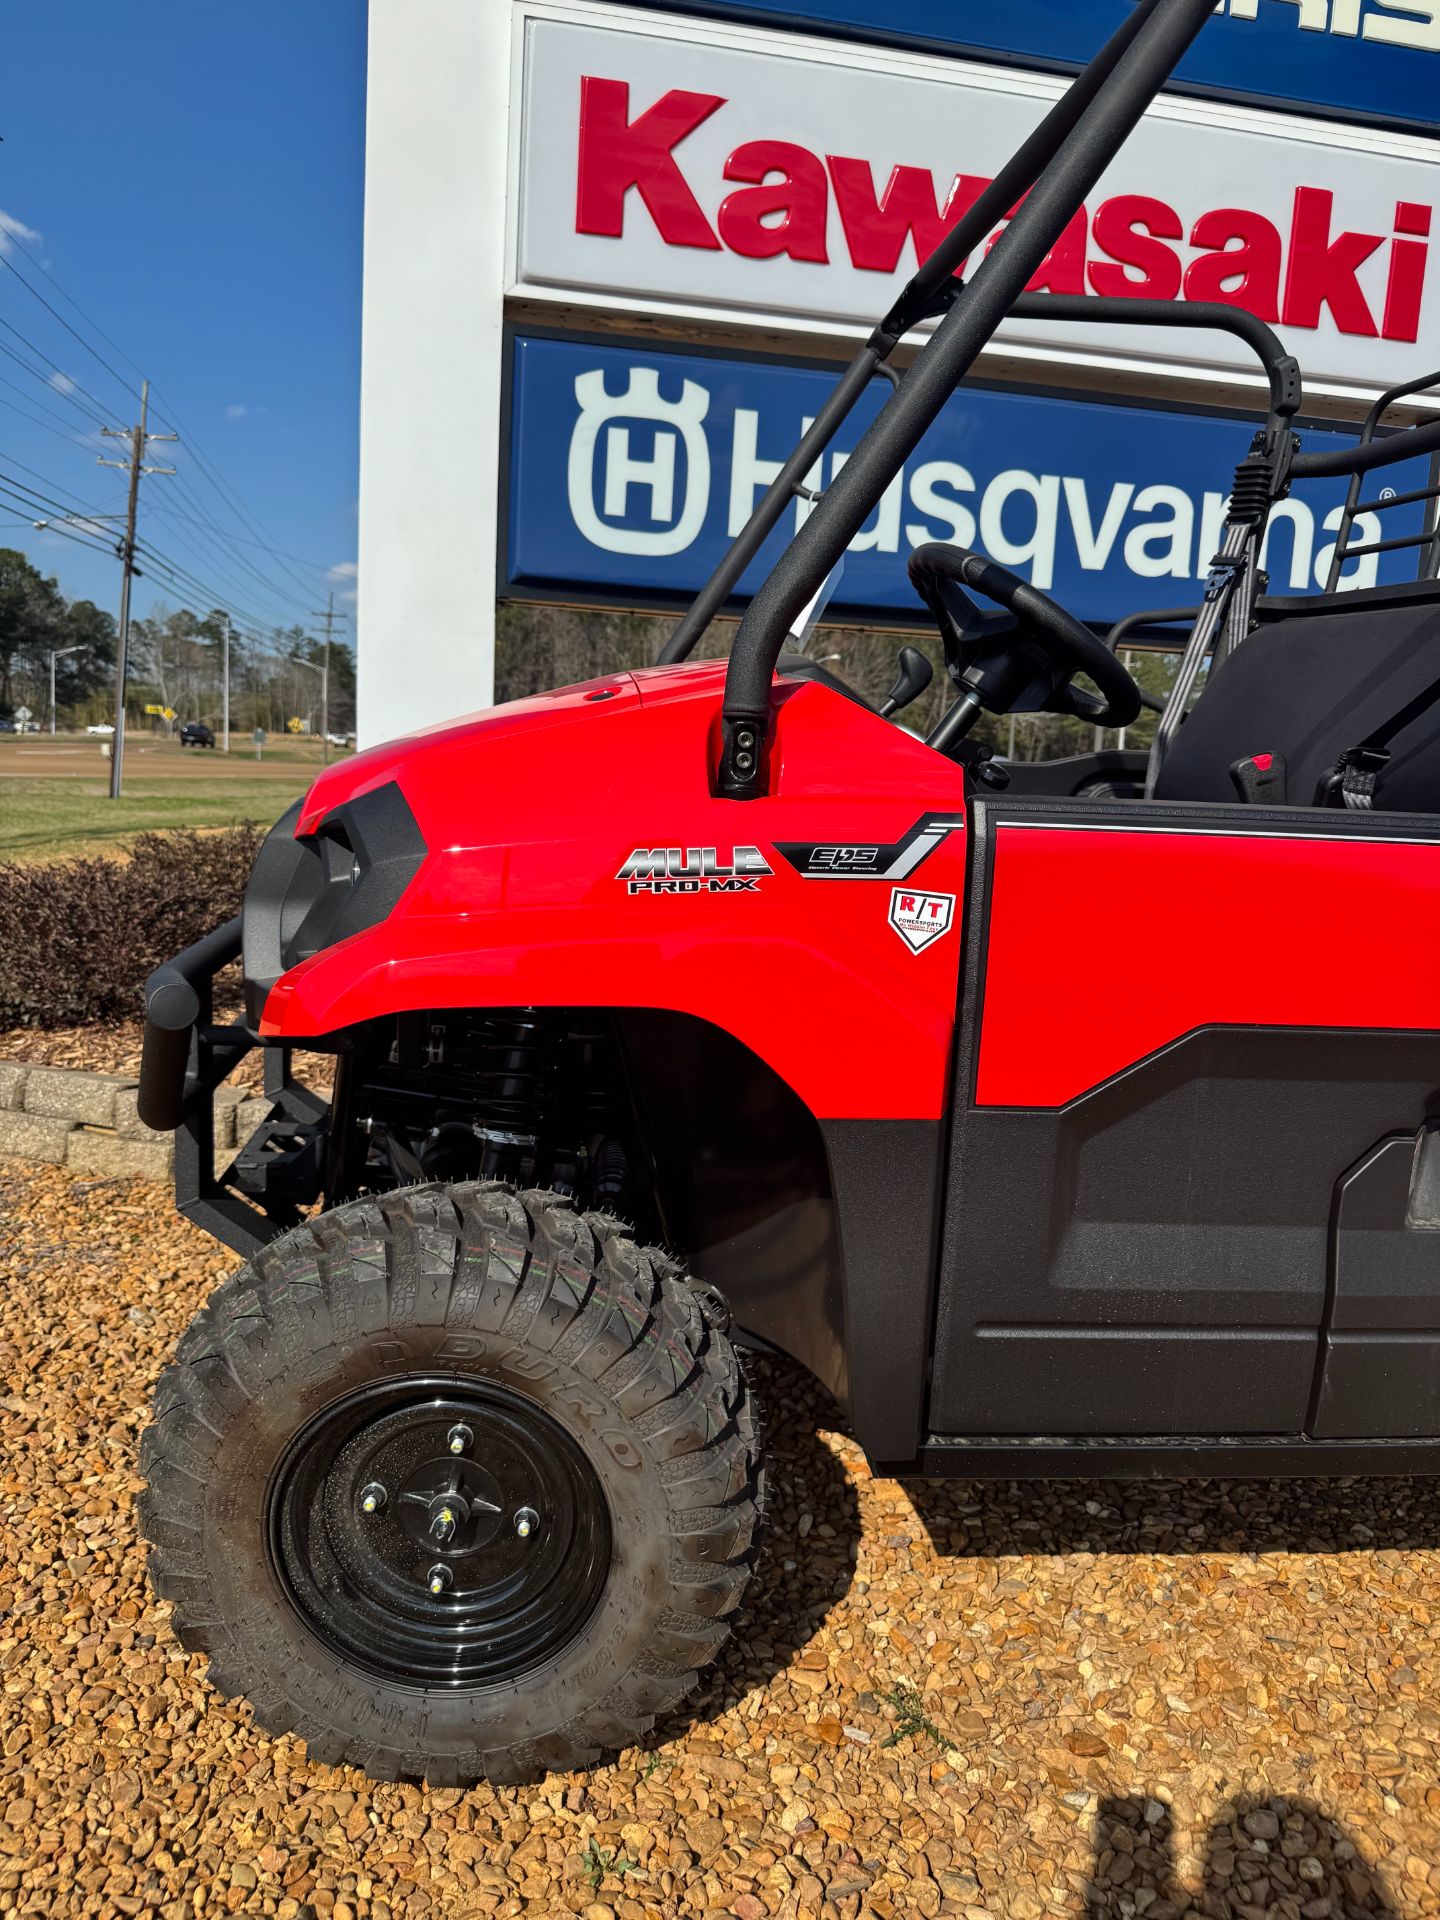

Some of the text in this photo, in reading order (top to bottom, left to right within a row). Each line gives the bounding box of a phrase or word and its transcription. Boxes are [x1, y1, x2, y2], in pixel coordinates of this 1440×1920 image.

[604, 426, 676, 522] H
[614, 845, 775, 879] MULE
[808, 847, 879, 867] EPS
[628, 877, 763, 895] PRO-MX
[898, 917, 943, 928] POWERSPORTS
